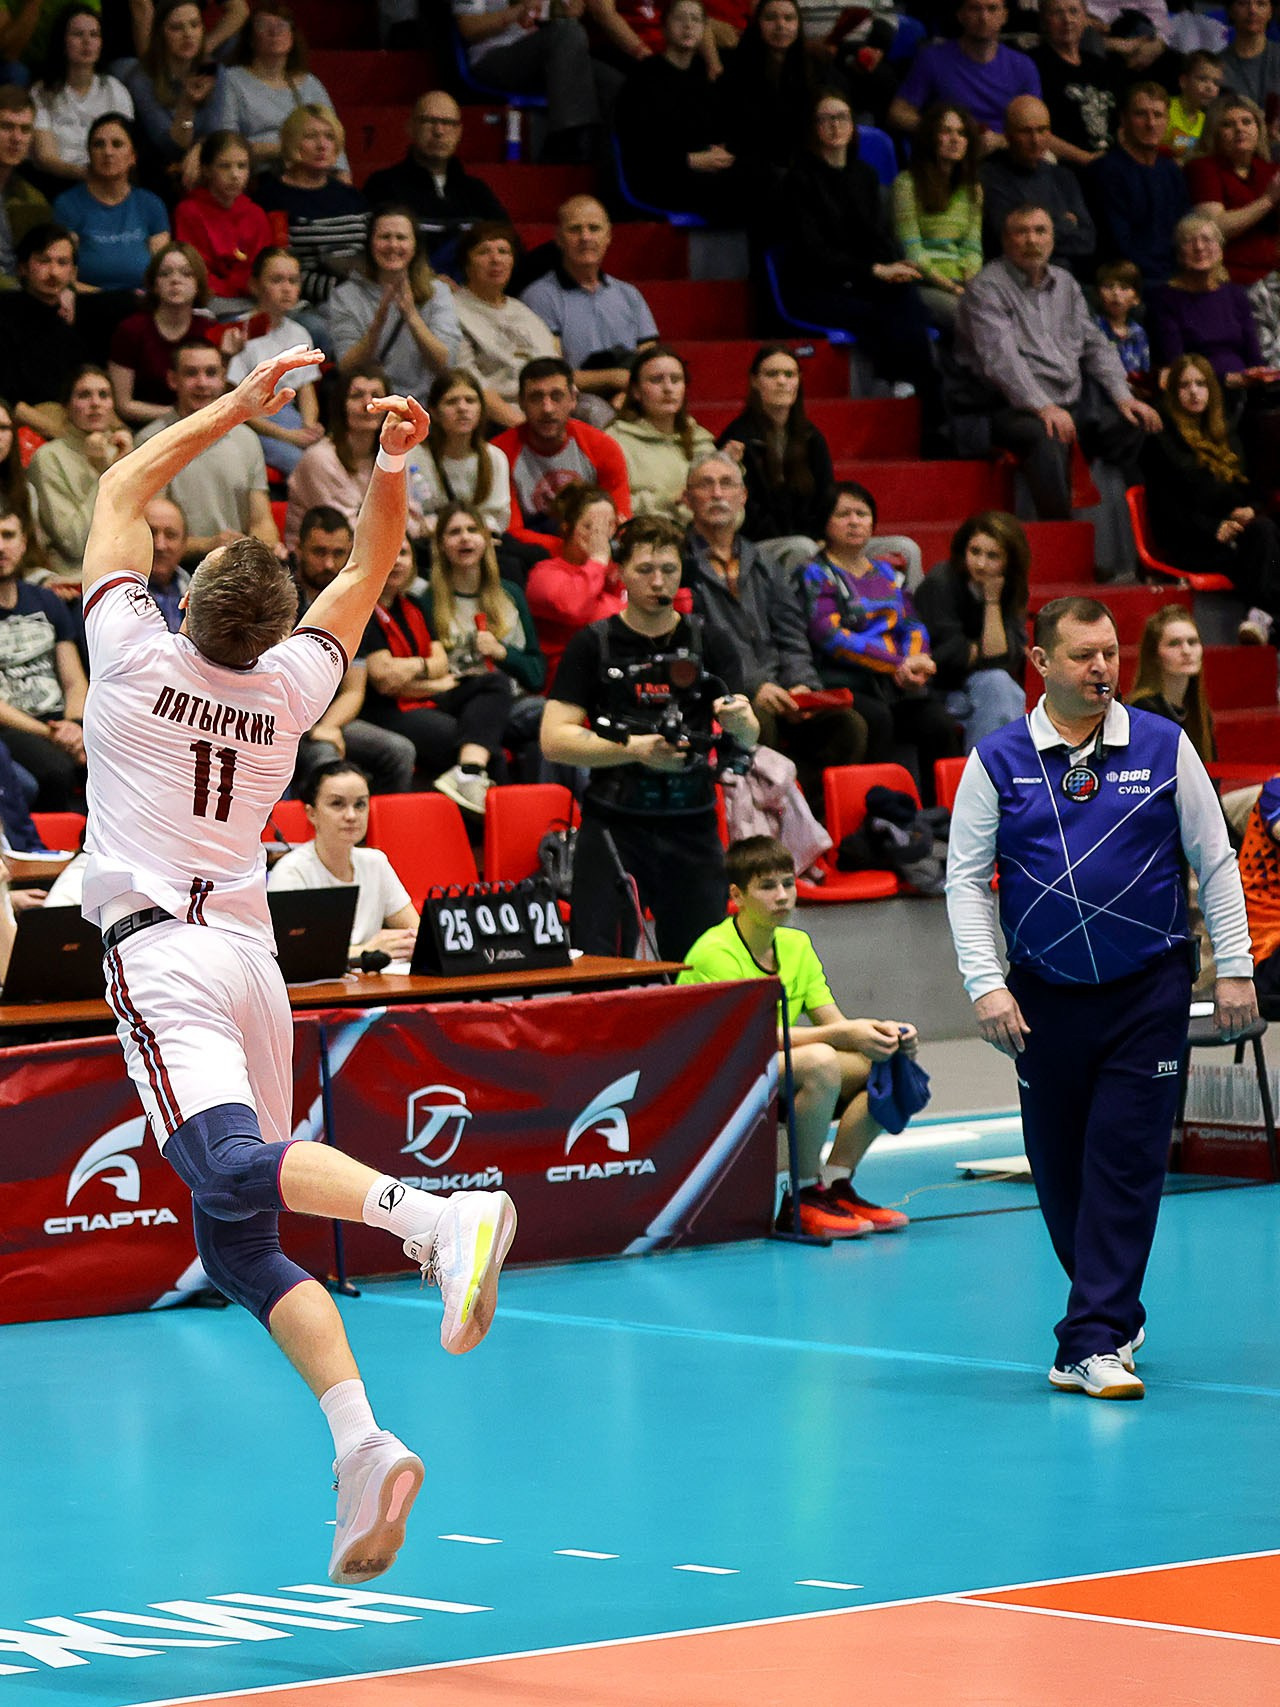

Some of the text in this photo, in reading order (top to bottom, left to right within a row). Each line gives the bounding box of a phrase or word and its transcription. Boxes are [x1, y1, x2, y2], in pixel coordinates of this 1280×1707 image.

[151, 685, 275, 746] ПЯТЫРКИН
[189, 738, 239, 823] 11
[1118, 785, 1151, 795] СУДЬЯ
[1119, 768, 1152, 783] ВФВ
[439, 901, 564, 951] 25 0 0 24
[399, 1158, 657, 1191] РЬКИЙ СПАРТА
[43, 1206, 180, 1235] СПАРТА
